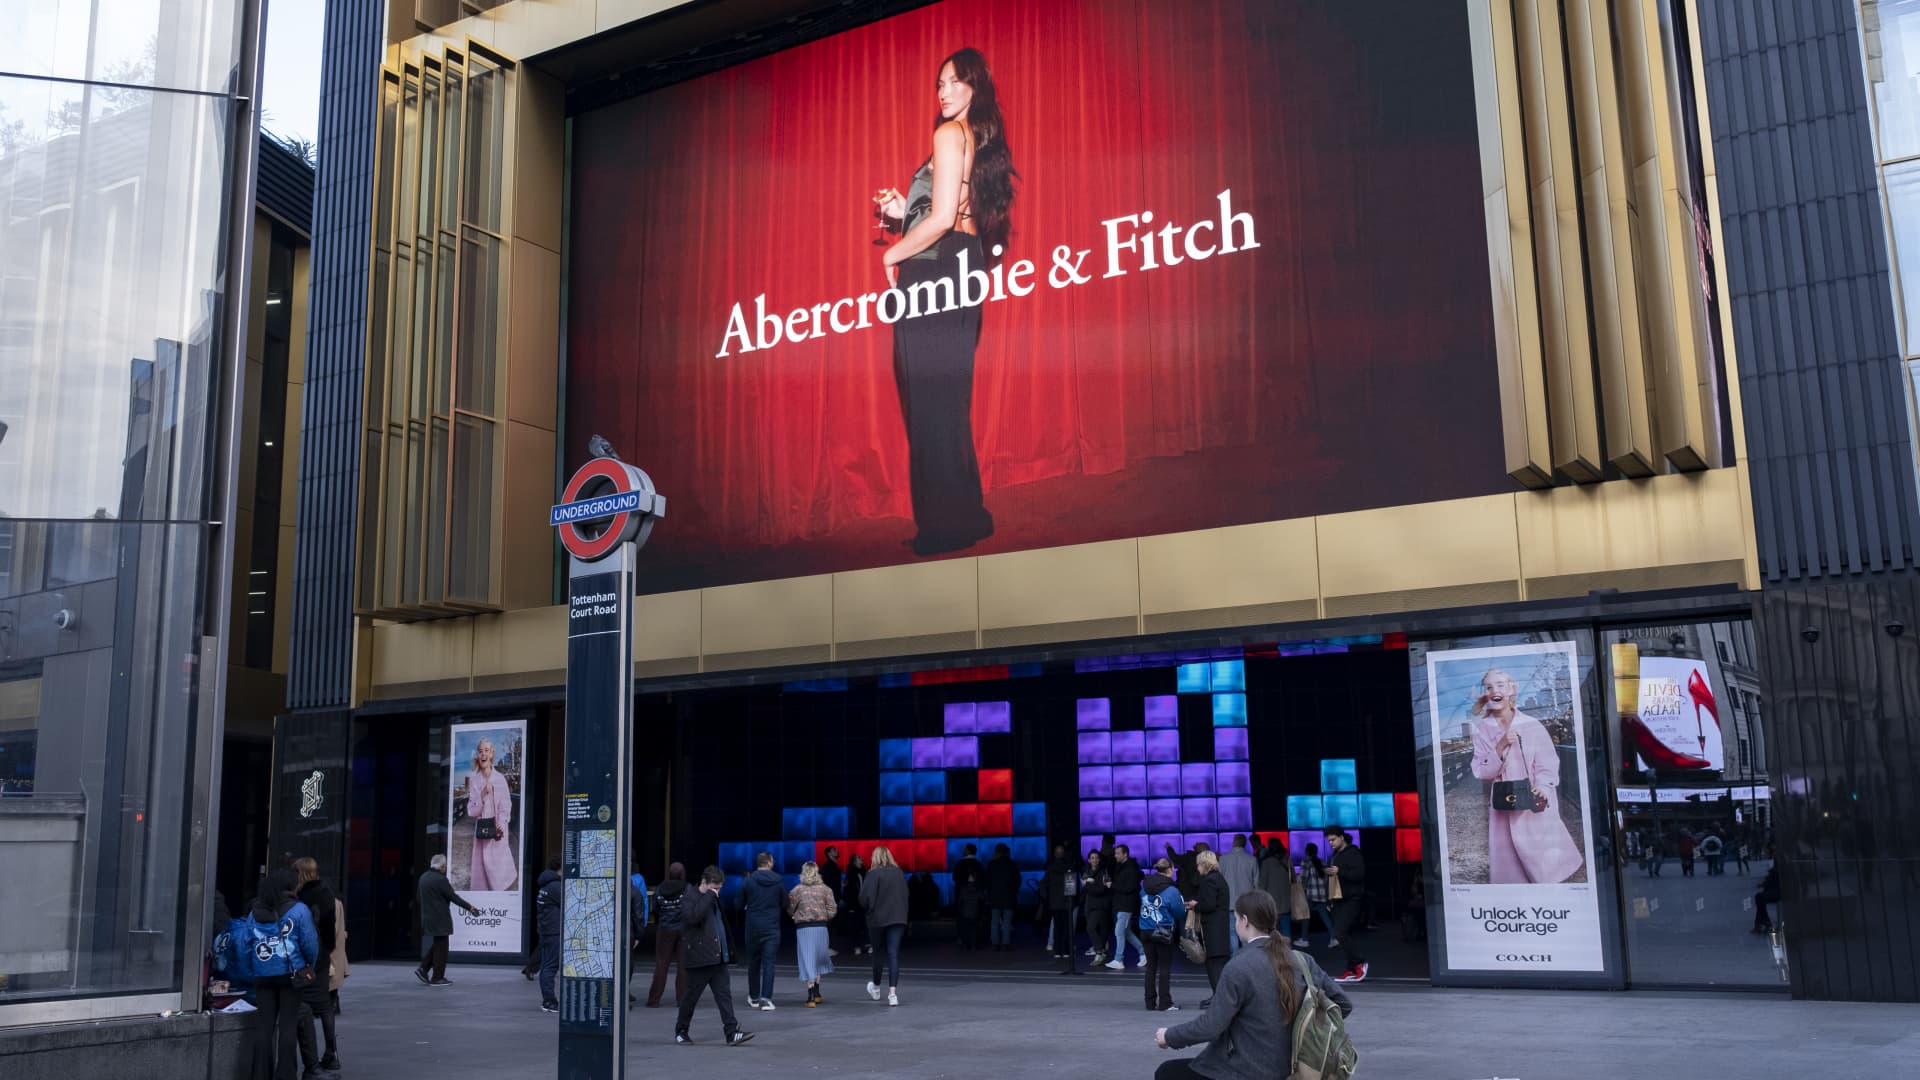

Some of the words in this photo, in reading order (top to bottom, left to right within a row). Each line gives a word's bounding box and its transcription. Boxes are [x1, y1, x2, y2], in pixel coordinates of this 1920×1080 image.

[715, 245, 1036, 359] Abercrombie
[1048, 244, 1092, 290] &
[1101, 189, 1261, 280] Fitch
[554, 495, 638, 521] UNDERGROUND
[571, 592, 616, 607] Tottenham
[570, 607, 592, 619] Court
[593, 603, 617, 616] Road
[458, 907, 488, 917] Unck
[489, 907, 508, 917] Your
[1470, 907, 1528, 920] Unlock
[1531, 907, 1571, 920] Your
[464, 916, 502, 928] Courage
[1484, 920, 1558, 936] Courage
[1495, 954, 1552, 962] COACH
